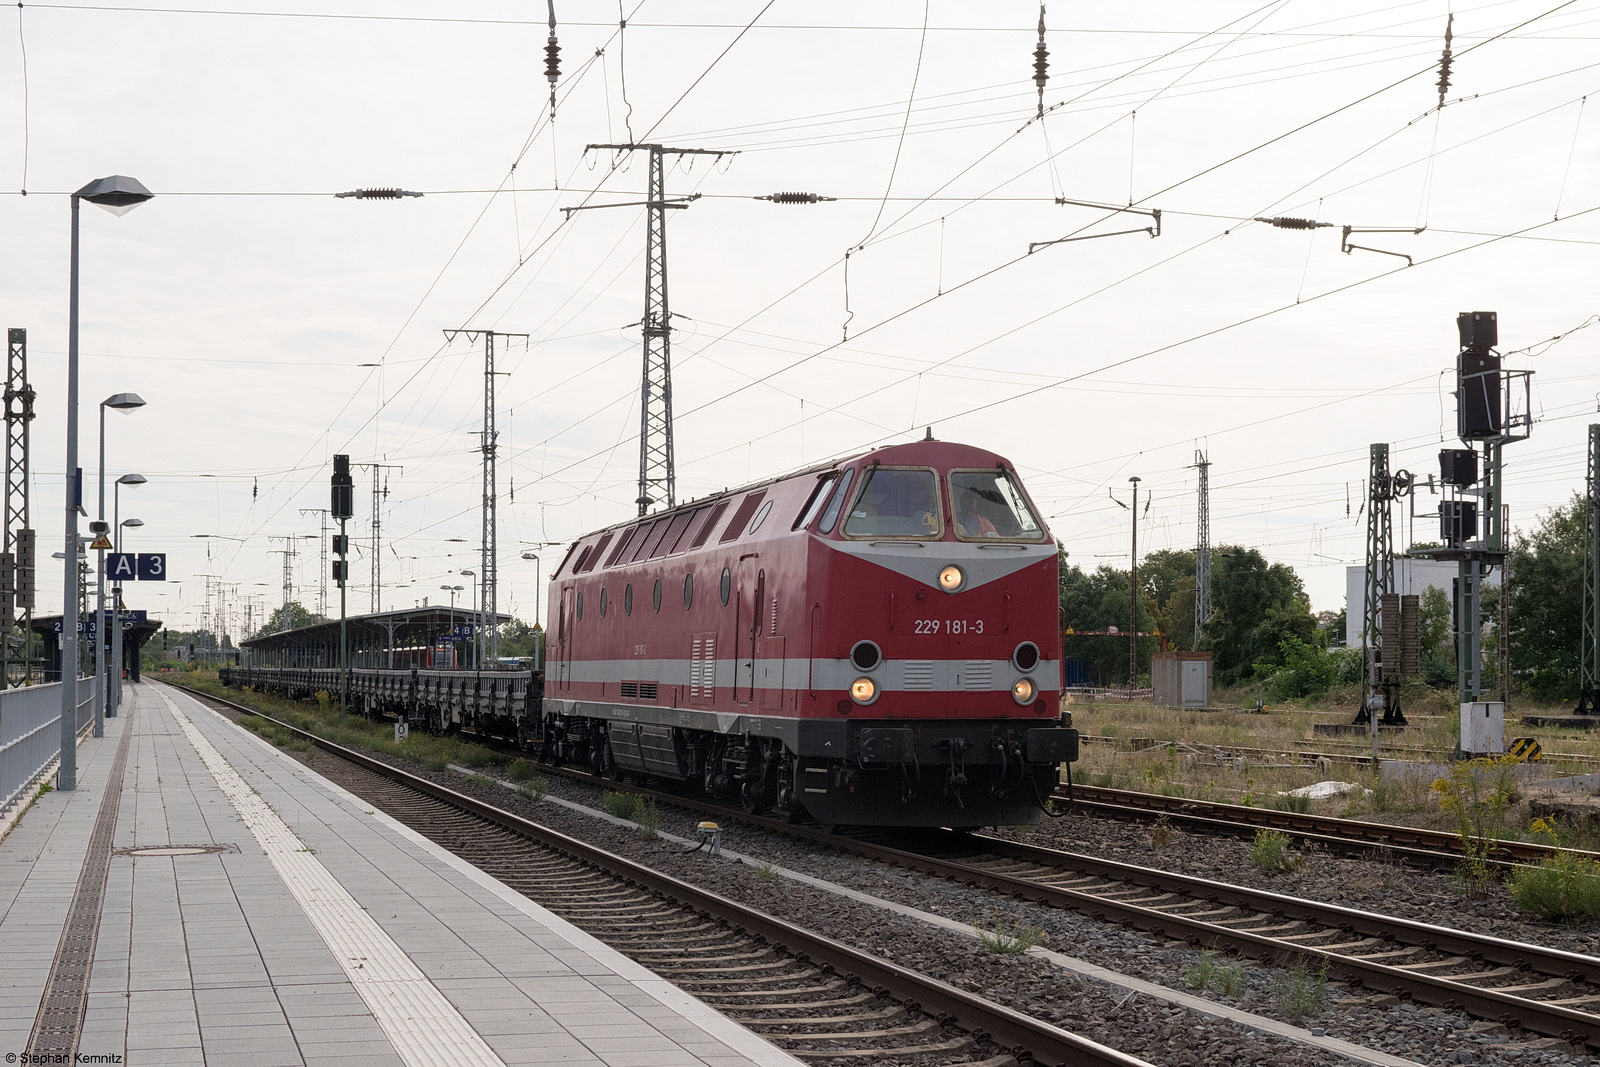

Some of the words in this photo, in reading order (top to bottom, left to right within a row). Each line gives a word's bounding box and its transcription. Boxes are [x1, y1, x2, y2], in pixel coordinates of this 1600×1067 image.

[115, 555, 132, 575] A
[149, 555, 163, 575] 3
[54, 622, 61, 632] 2
[76, 622, 84, 632] B
[89, 622, 96, 632] 3
[453, 626, 460, 635] 4
[464, 626, 471, 635] B
[914, 619, 941, 634] 229
[945, 619, 984, 634] 181-3
